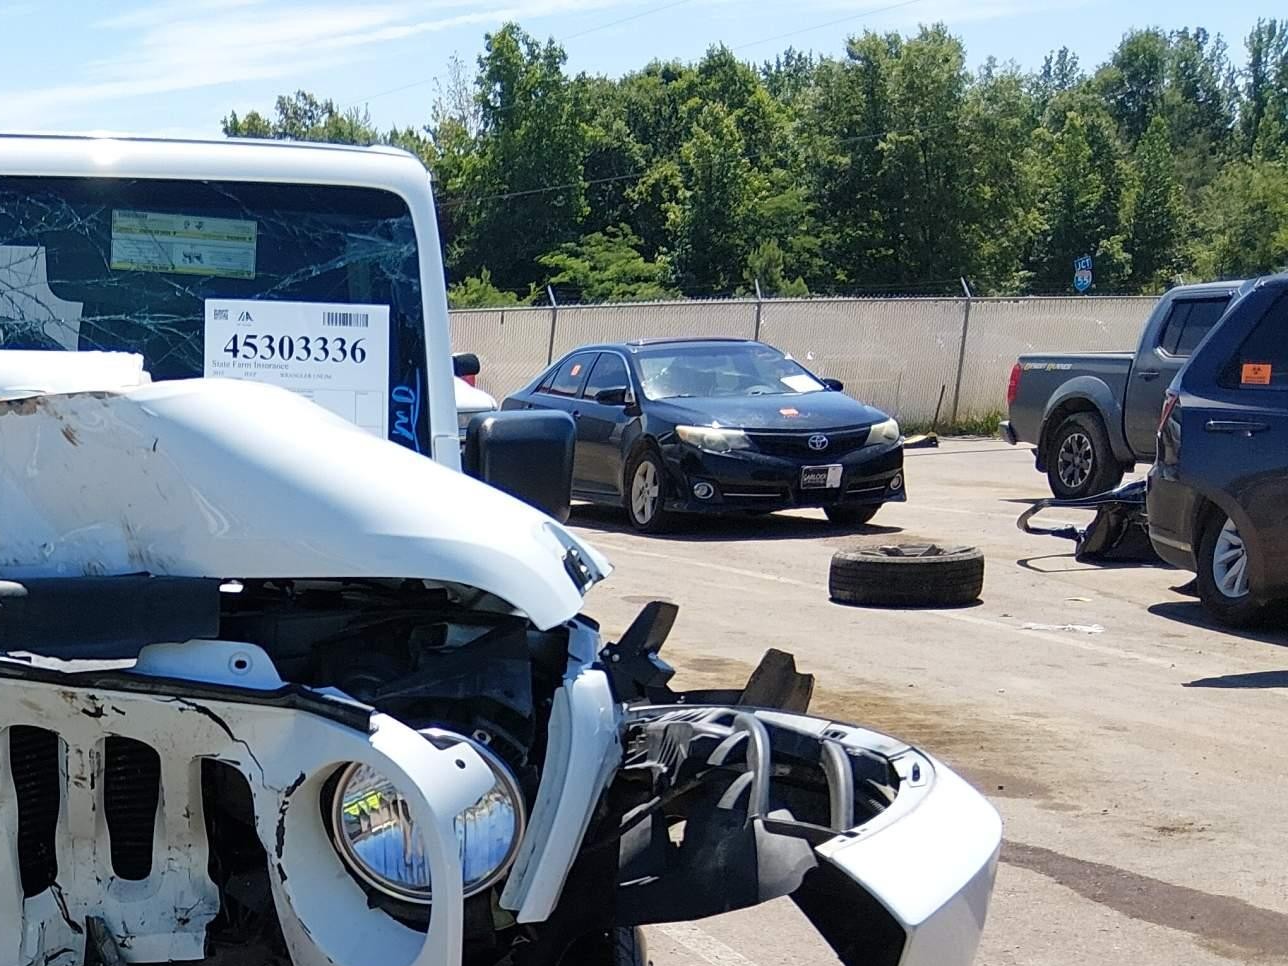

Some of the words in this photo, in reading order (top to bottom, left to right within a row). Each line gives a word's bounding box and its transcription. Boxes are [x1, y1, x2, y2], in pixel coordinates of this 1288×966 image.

[223, 333, 367, 363] 45303336
[211, 360, 230, 368] State
[232, 360, 252, 369] Farm
[253, 360, 289, 370] Insurance
